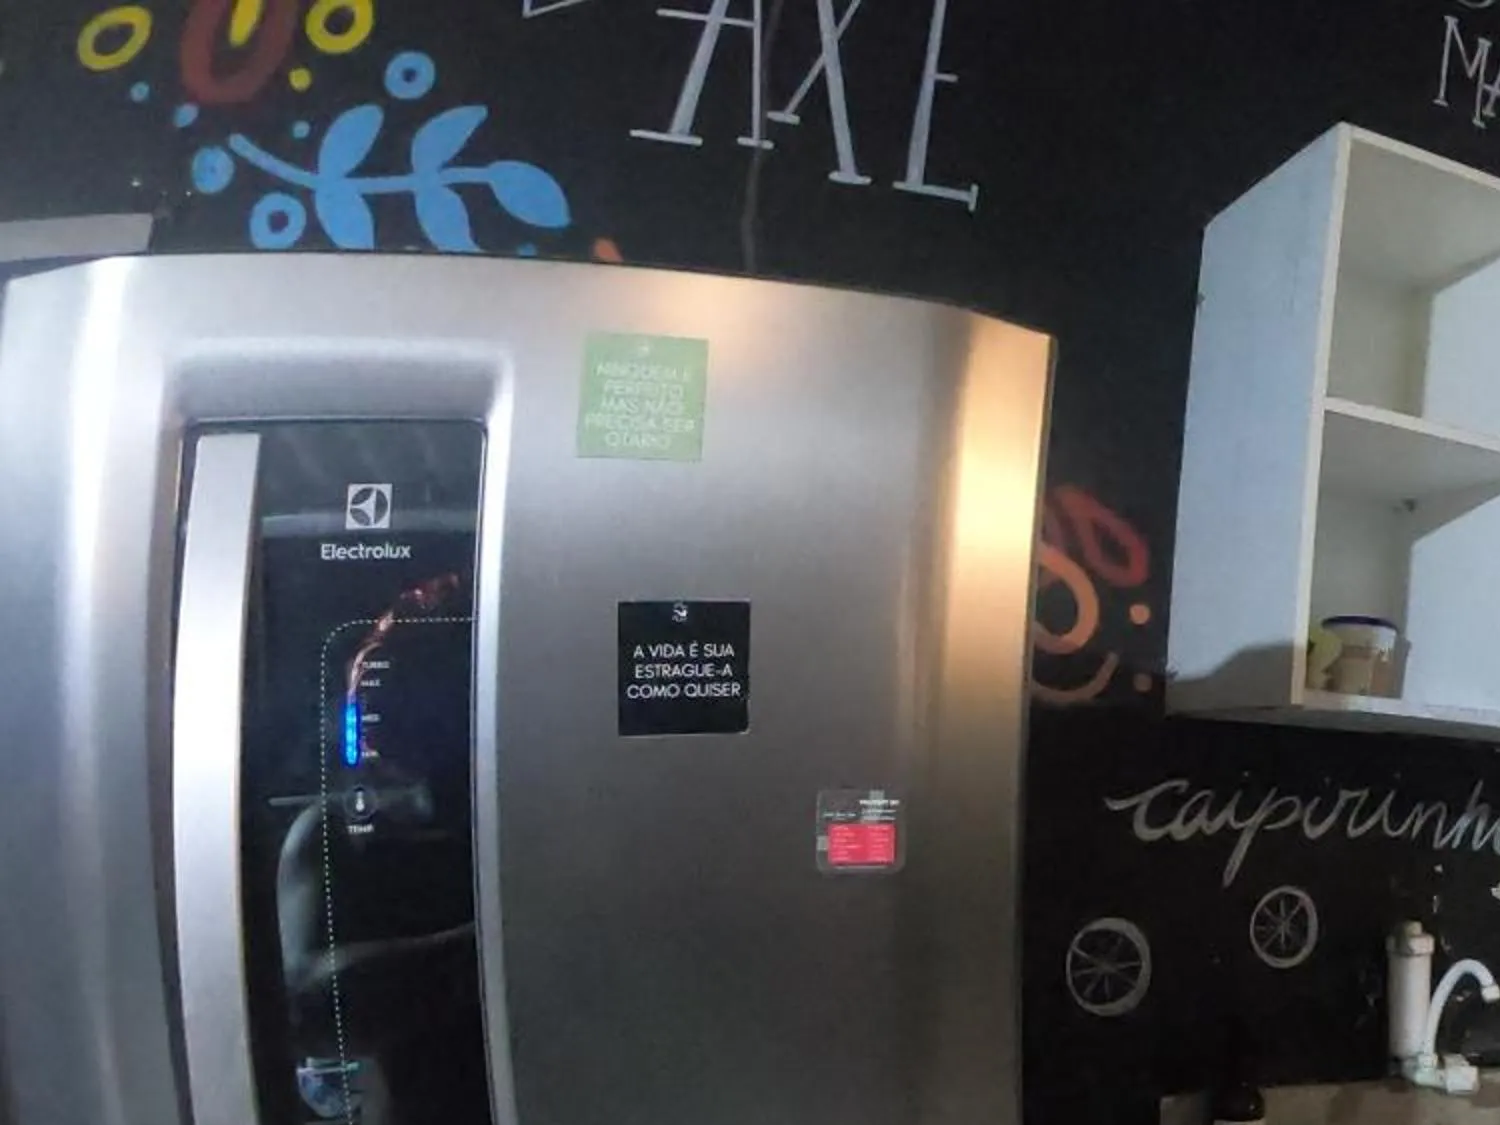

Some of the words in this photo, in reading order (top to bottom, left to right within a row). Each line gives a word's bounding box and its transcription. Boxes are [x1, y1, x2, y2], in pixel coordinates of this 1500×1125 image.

[320, 542, 412, 560] Electrolux
[633, 645, 645, 659] A
[648, 643, 685, 659] VIDA
[688, 639, 699, 658] É
[703, 642, 735, 658] SUA
[634, 662, 734, 680] ESTRAGUE-A
[626, 683, 680, 700] COMO
[683, 682, 742, 699] QUISER
